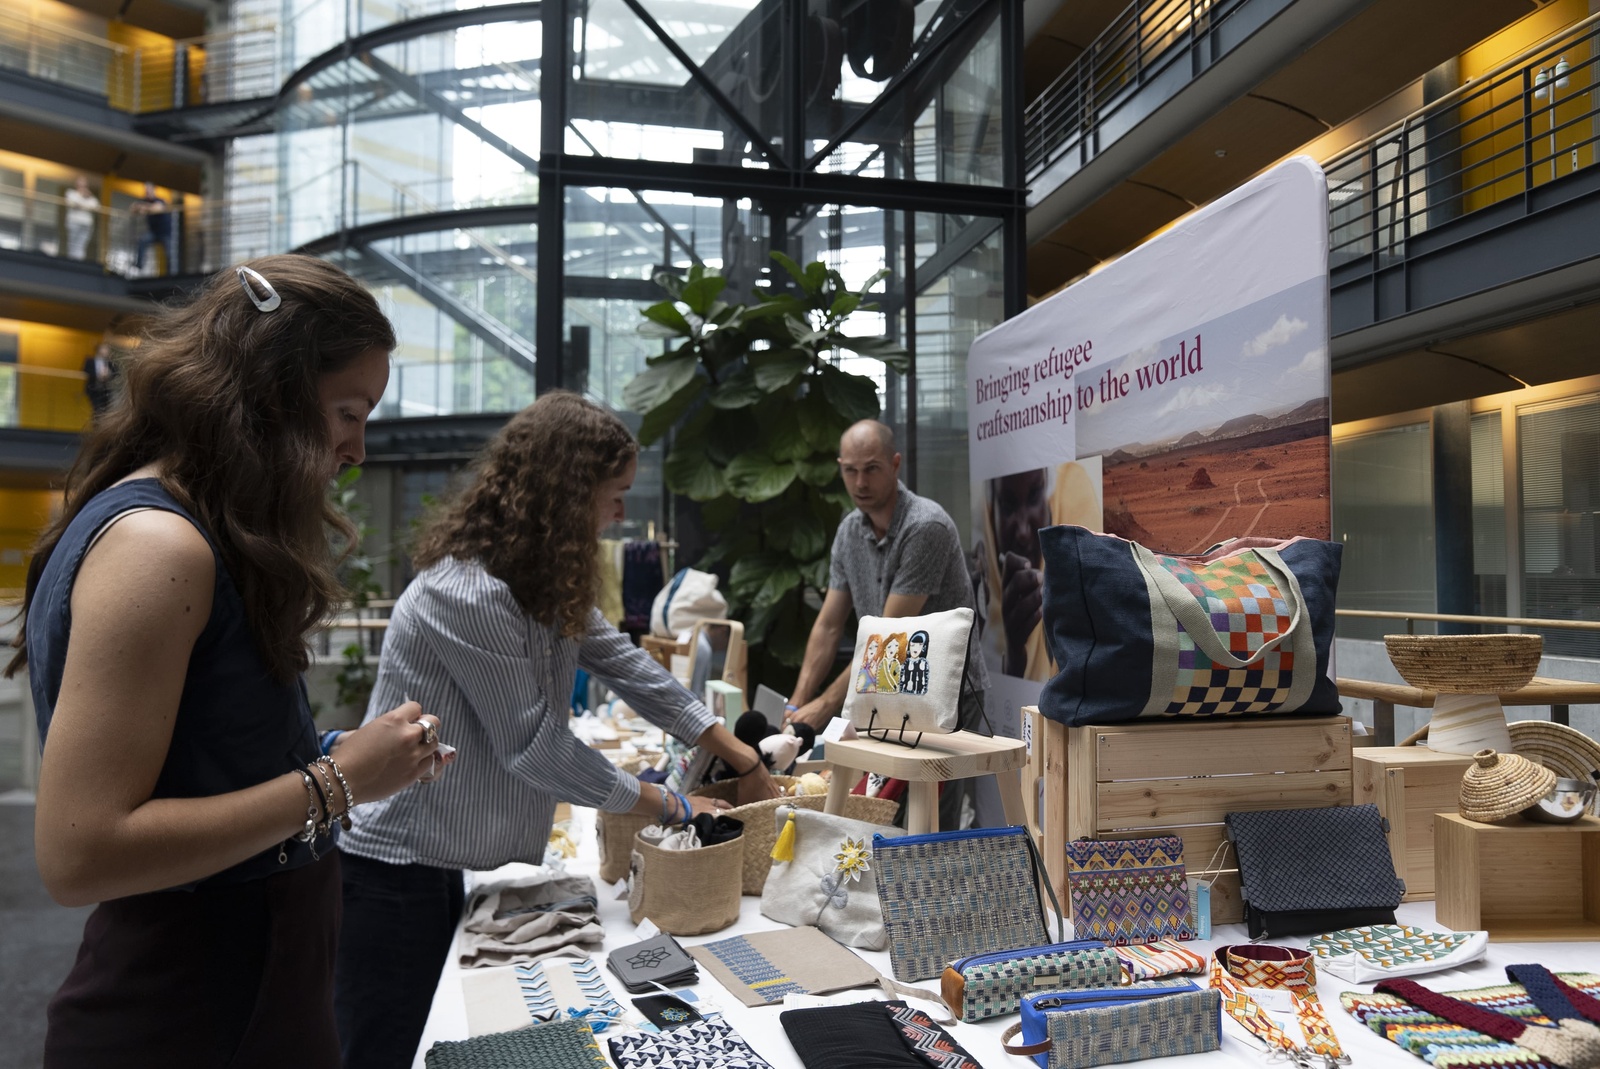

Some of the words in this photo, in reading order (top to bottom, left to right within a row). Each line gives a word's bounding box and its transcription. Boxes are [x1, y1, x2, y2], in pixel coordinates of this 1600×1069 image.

[976, 366, 1030, 404] Bringing
[1034, 340, 1092, 383] refugee
[976, 388, 1072, 441] craftsmanship
[1077, 385, 1094, 411] to
[1099, 368, 1130, 404] the
[1135, 333, 1203, 391] world
